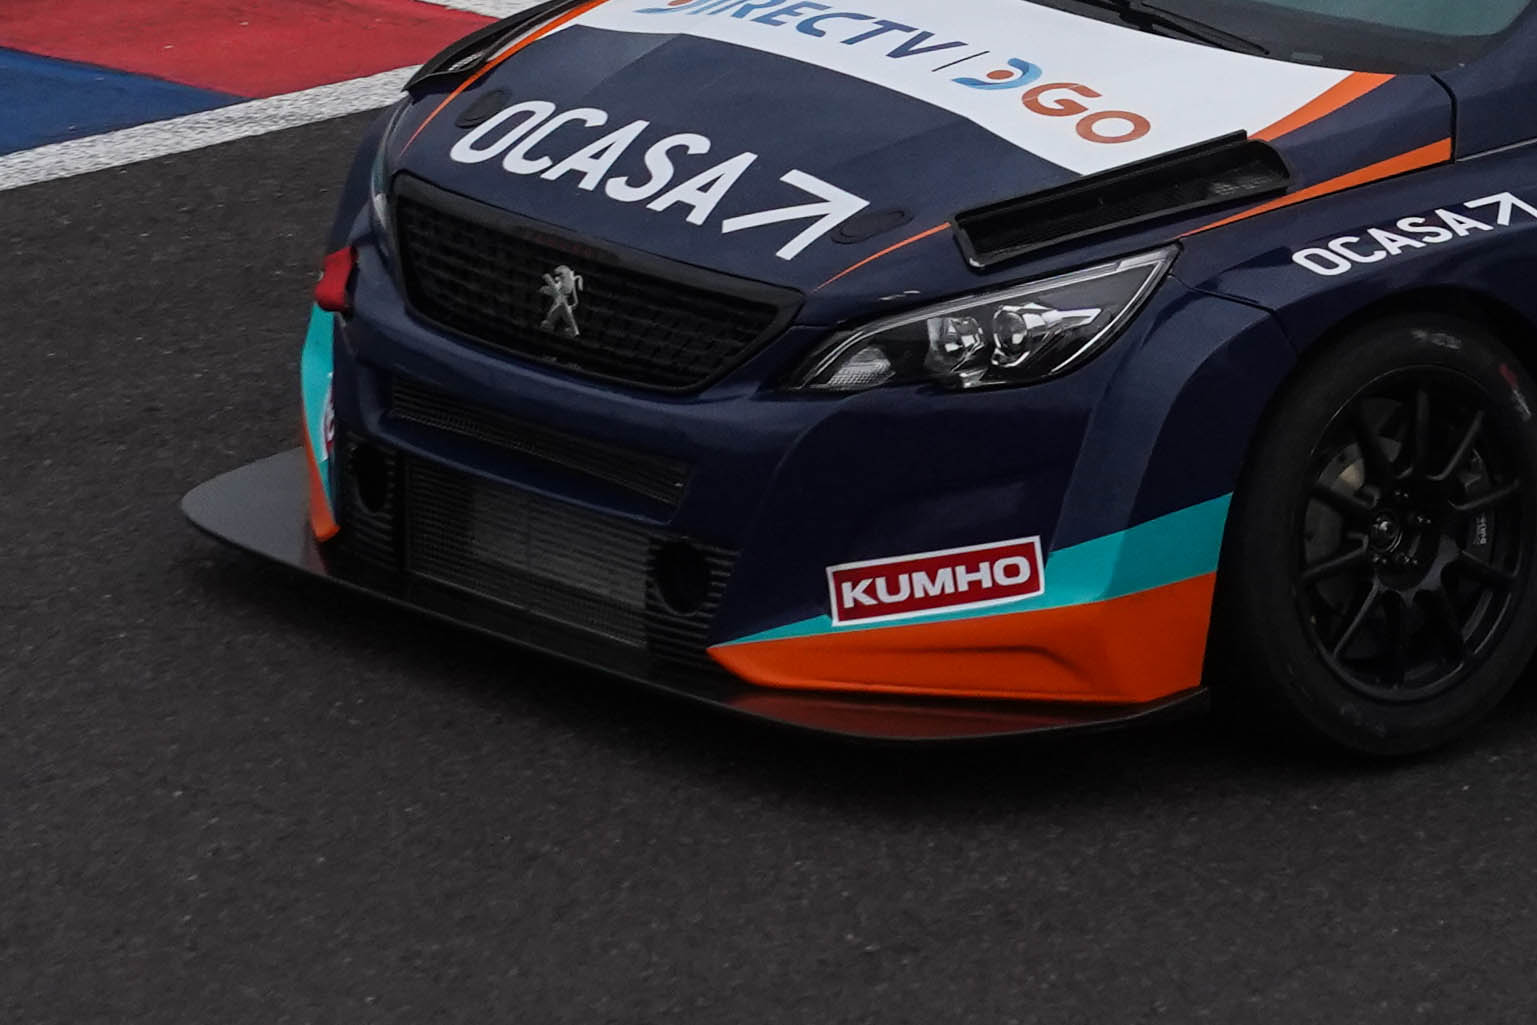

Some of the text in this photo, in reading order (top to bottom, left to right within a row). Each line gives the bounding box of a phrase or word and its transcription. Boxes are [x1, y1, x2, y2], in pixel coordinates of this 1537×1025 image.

[448, 99, 760, 226] OCASA
[1292, 207, 1494, 277] OCASA
[840, 555, 1032, 610] KUMHO
